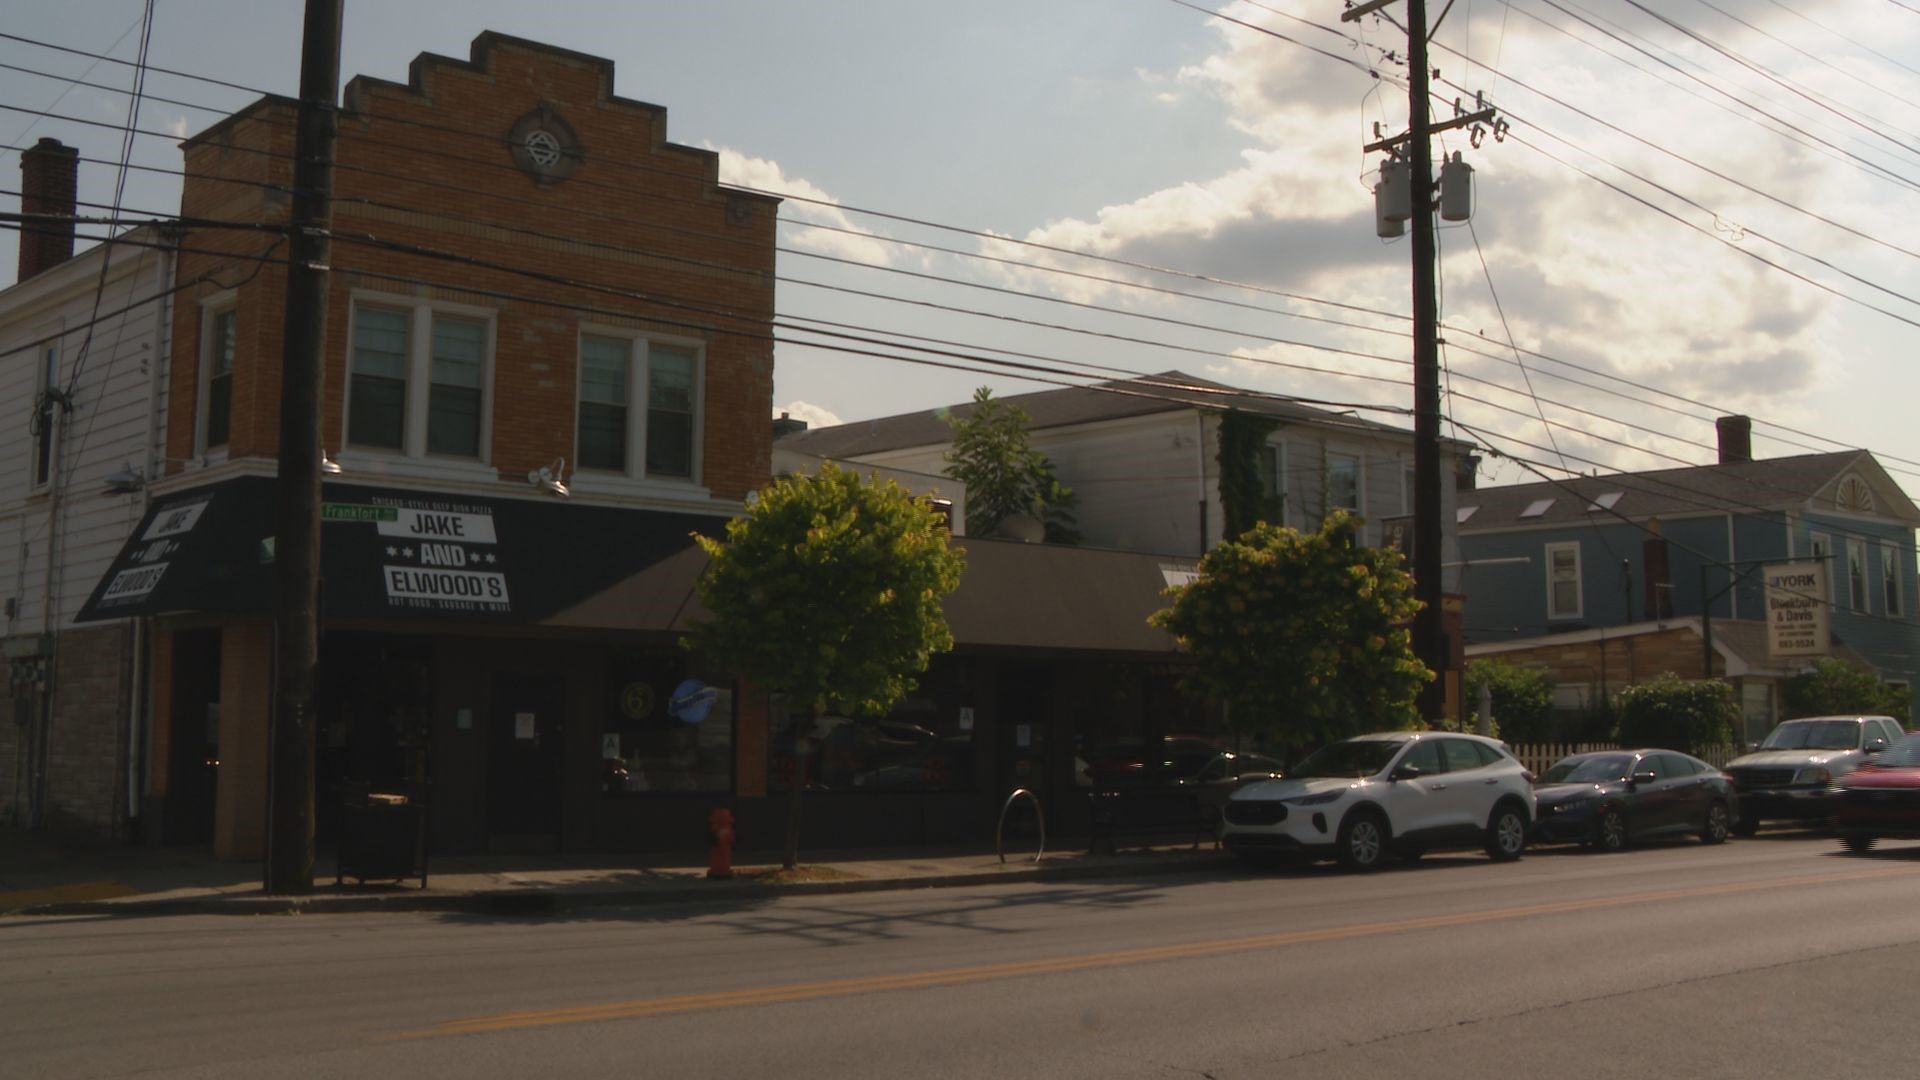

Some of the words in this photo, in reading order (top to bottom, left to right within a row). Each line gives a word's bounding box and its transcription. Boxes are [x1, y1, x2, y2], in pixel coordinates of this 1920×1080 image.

[326, 504, 379, 520] Frankfort
[410, 514, 464, 537] JAKE
[420, 543, 466, 567] AND
[391, 571, 503, 598] ELWOOD'S
[1780, 573, 1816, 587] YORK
